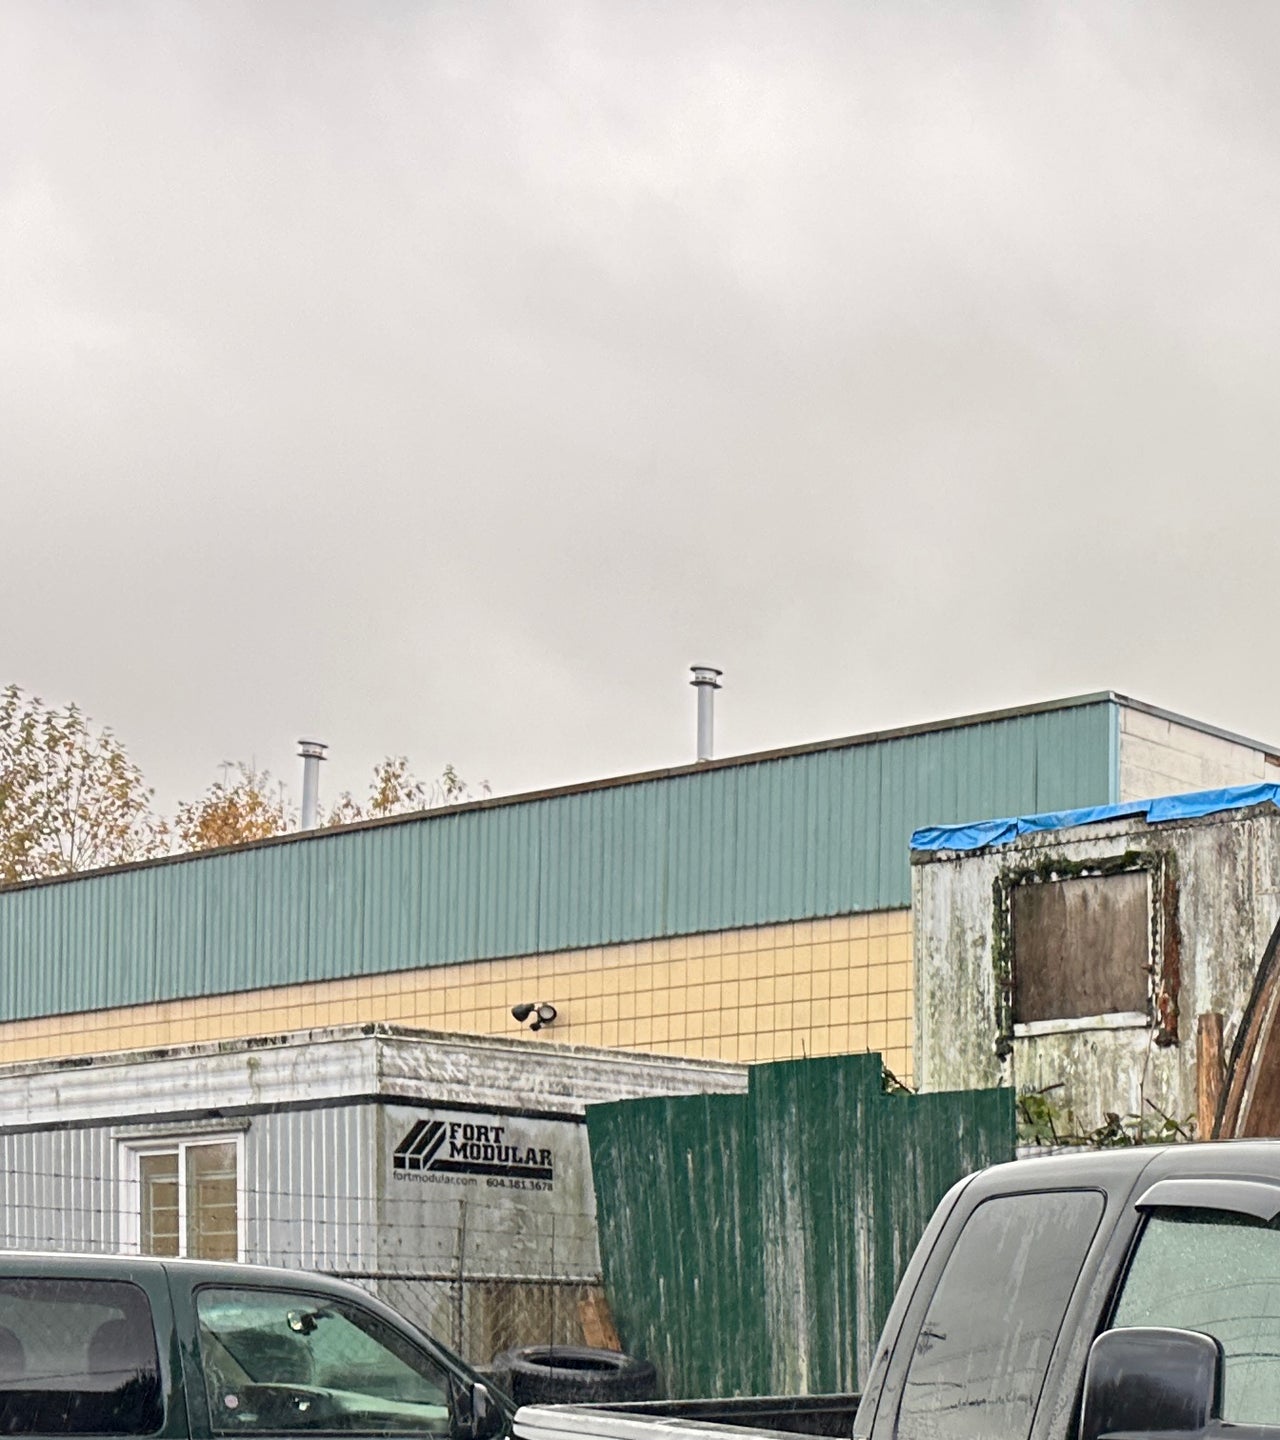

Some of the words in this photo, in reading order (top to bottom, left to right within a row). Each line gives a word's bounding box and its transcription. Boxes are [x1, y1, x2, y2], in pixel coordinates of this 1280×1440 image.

[448, 1122, 505, 1144] FORT
[448, 1141, 553, 1167] MODULAR
[392, 1170, 478, 1187] fortmodular.com
